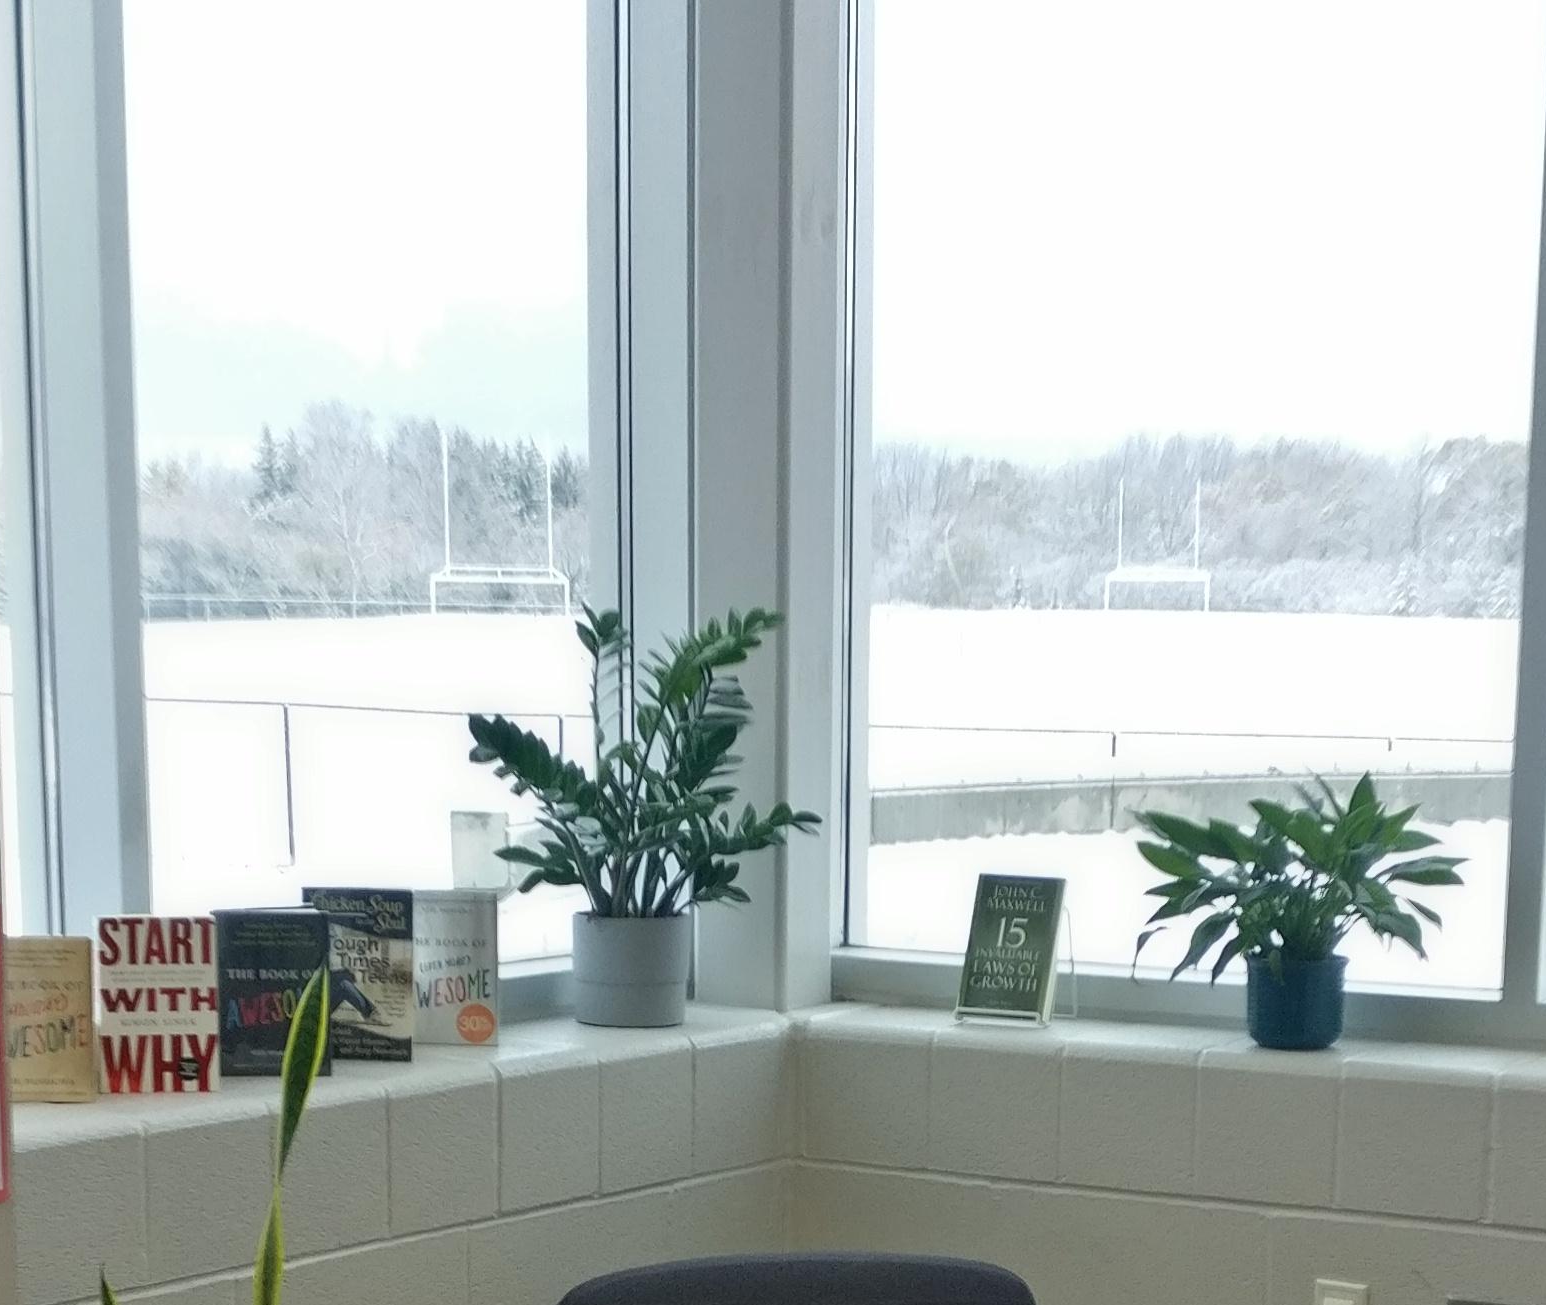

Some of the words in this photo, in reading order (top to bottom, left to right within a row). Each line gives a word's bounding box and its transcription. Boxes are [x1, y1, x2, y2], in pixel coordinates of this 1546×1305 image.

[98, 917, 217, 966] START
[331, 936, 379, 955] ough
[996, 916, 1029, 949] 15
[100, 986, 219, 1013] WITH
[414, 967, 492, 1010] WESOME
[100, 1033, 219, 1094] WHY
